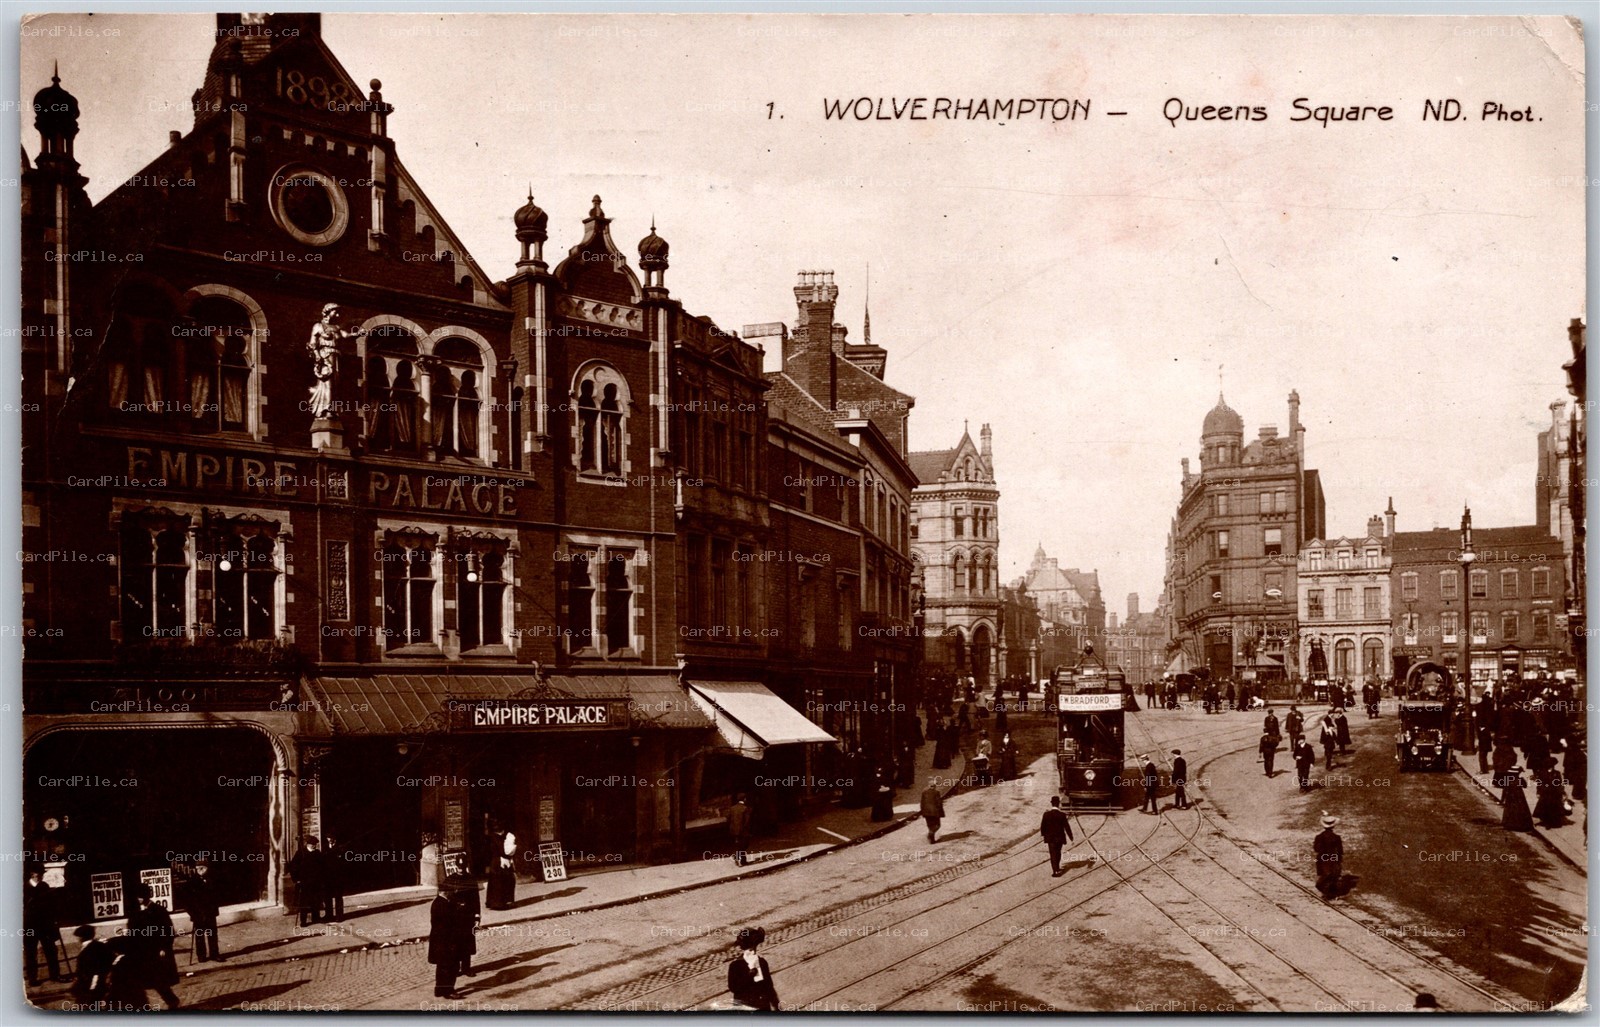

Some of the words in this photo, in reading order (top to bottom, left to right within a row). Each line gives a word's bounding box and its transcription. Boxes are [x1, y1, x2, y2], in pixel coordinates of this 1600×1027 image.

[276, 66, 350, 115] 1898
[127, 446, 298, 497] EMPIRE
[369, 470, 519, 516] PALACE
[1070, 696, 1110, 704] BRADFORD
[474, 707, 540, 726] EMPIRE
[545, 706, 607, 724] PALACE
[142, 869, 170, 877] ANIMATED
